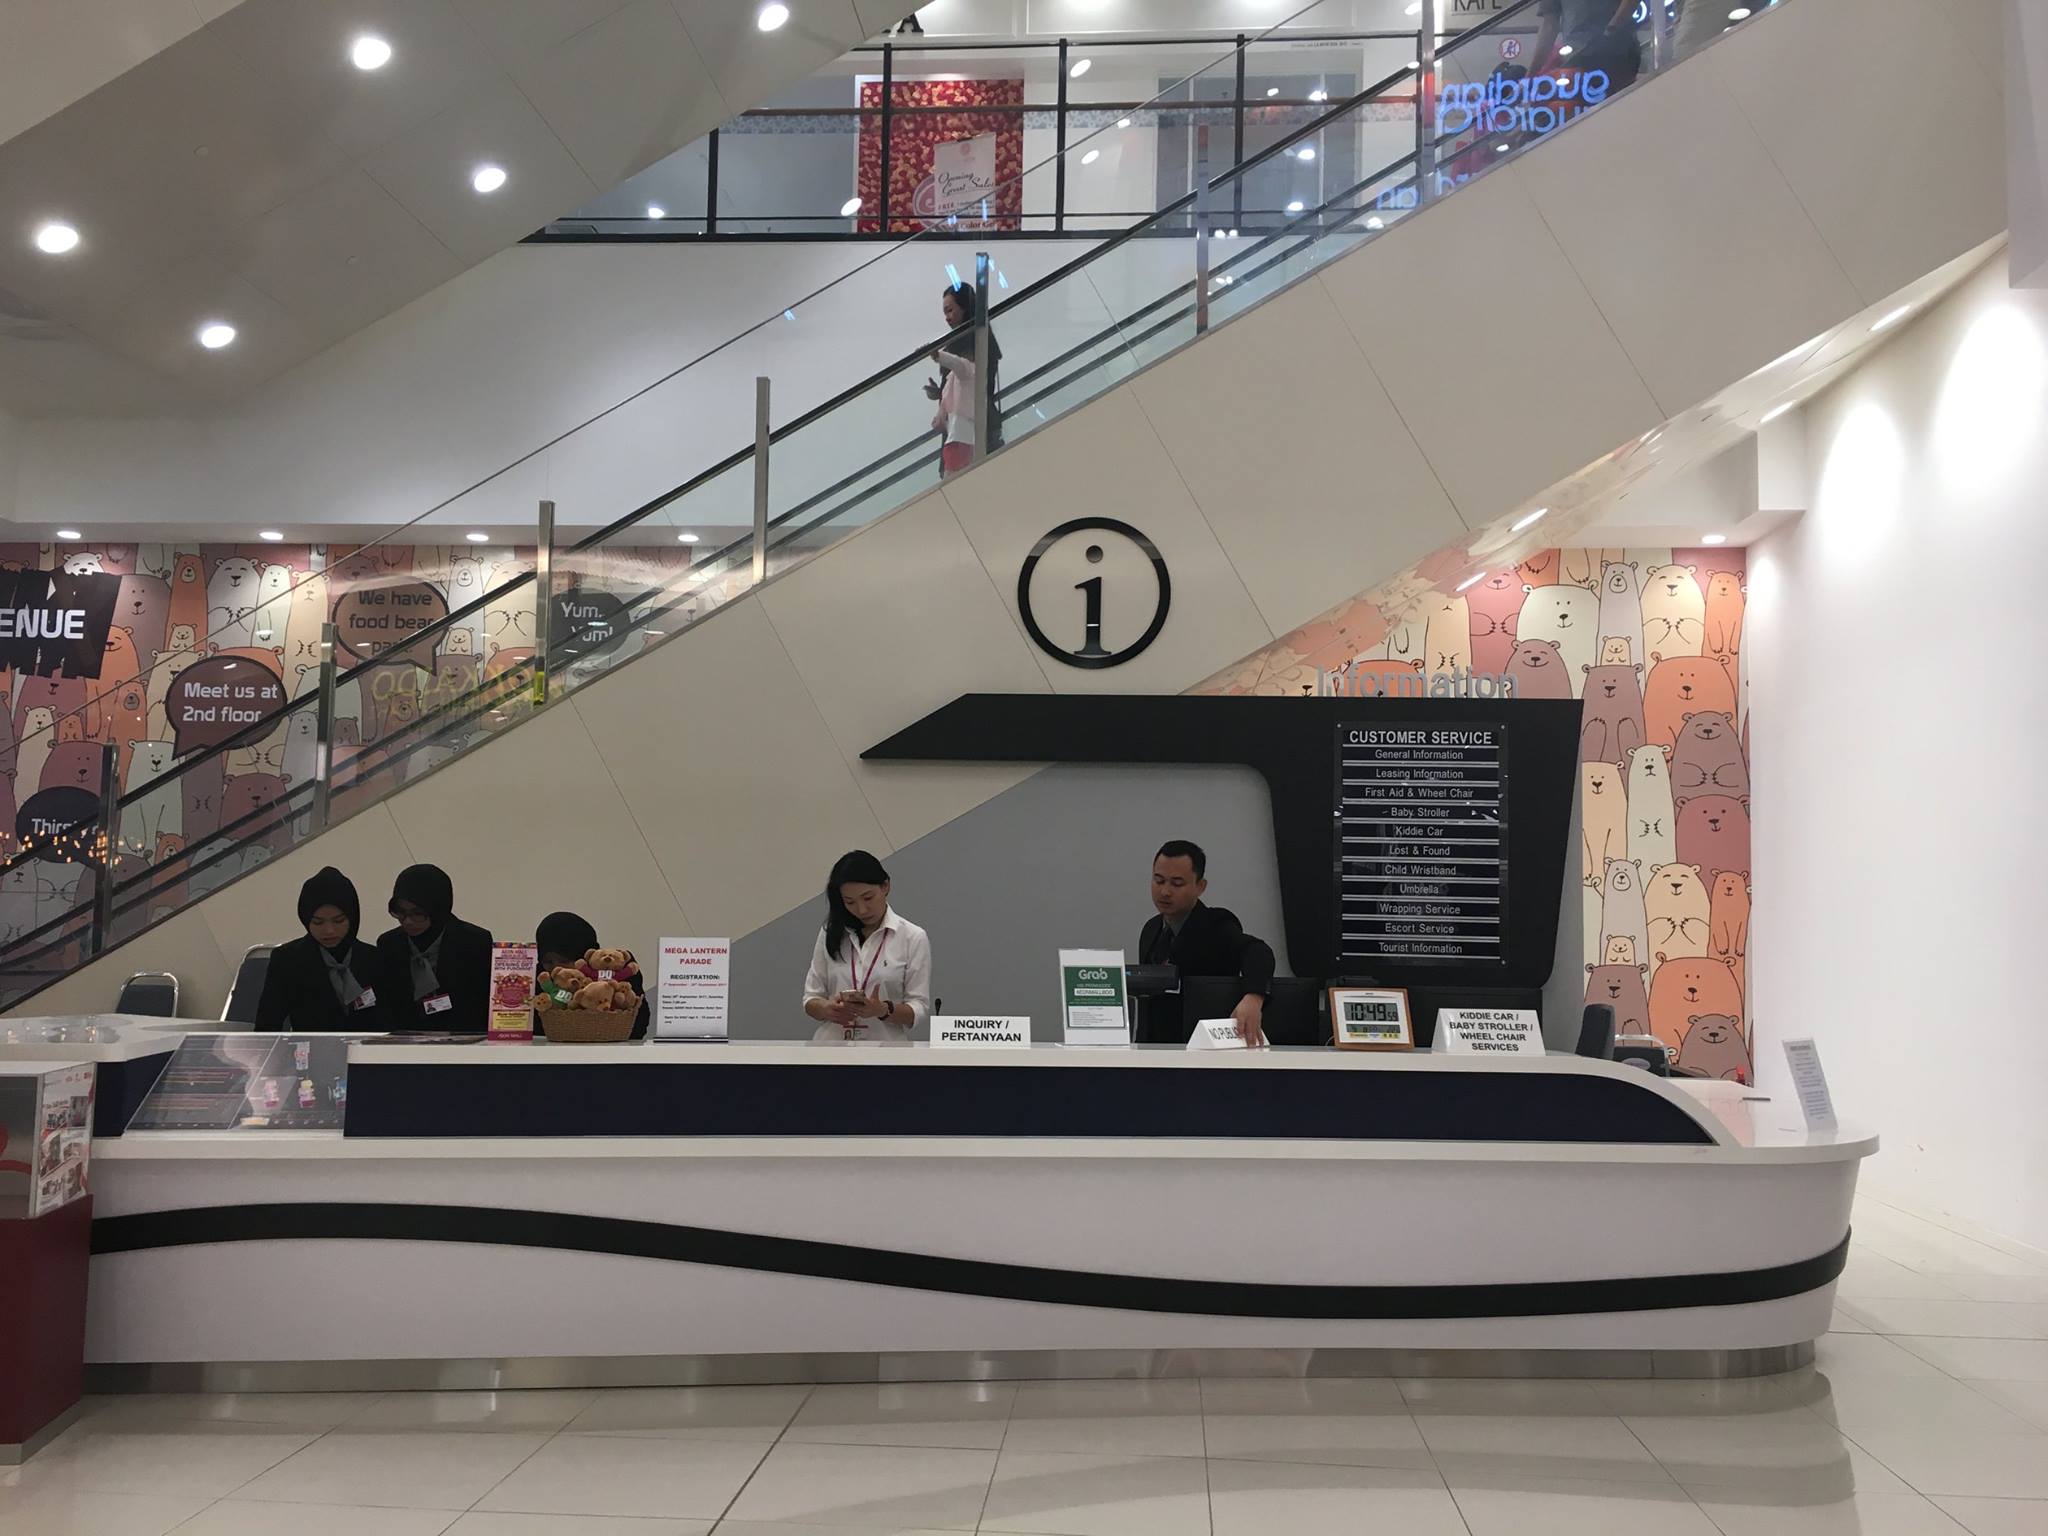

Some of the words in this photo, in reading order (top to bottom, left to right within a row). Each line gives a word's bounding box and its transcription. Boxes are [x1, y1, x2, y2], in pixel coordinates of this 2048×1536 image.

[391, 591, 432, 606] have
[349, 613, 389, 629] food
[1317, 662, 1518, 697] Information
[184, 682, 229, 698] Meet
[235, 686, 255, 698] us
[261, 684, 278, 699] at
[182, 705, 216, 722] 2nd
[221, 705, 261, 722] floor
[1350, 731, 1426, 744] CUSTOMER
[1431, 731, 1492, 745] SERVICE
[1375, 749, 1410, 759] General
[1413, 749, 1463, 760] Information
[1376, 769, 1410, 780] Leasing
[1413, 769, 1463, 779] Information
[1365, 787, 1385, 797] First
[1389, 787, 1403, 797] Aid
[1407, 788, 1414, 797] &
[1418, 788, 1447, 798] Wheel
[1450, 788, 1473, 798] Chair
[1391, 807, 1413, 818] Baby
[1417, 807, 1450, 818] Stroller
[1395, 826, 1424, 836] Kiddie
[1427, 826, 1444, 836] Car
[1389, 845, 1409, 855] Lost
[1412, 846, 1420, 855] &
[1423, 846, 1450, 855] Found
[1384, 864, 1407, 874] Child
[1411, 865, 1457, 875] Wristband
[1400, 884, 1439, 894] Umbrella
[1380, 903, 1422, 915] Wrapping
[1425, 904, 1461, 914] Service
[1385, 922, 1415, 933] Escort
[1419, 923, 1455, 934] Service
[664, 947, 688, 955] MEGA
[690, 947, 727, 955] LANTERN
[1379, 942, 1409, 952] Tourist
[1412, 943, 1463, 954] Information
[1078, 968, 1108, 980] Grab
[1460, 1012, 1491, 1020] KIDDIE
[954, 1019, 1002, 1029] INQUIRY
[1449, 1022, 1476, 1030] BABY
[1478, 1023, 1528, 1031] STROLLER
[941, 1032, 1022, 1042] PERTANYAAN
[1460, 1032, 1494, 1041] WHEEL
[1496, 1033, 1526, 1041] CHAIR
[1471, 1042, 1520, 1052] SERVICES
